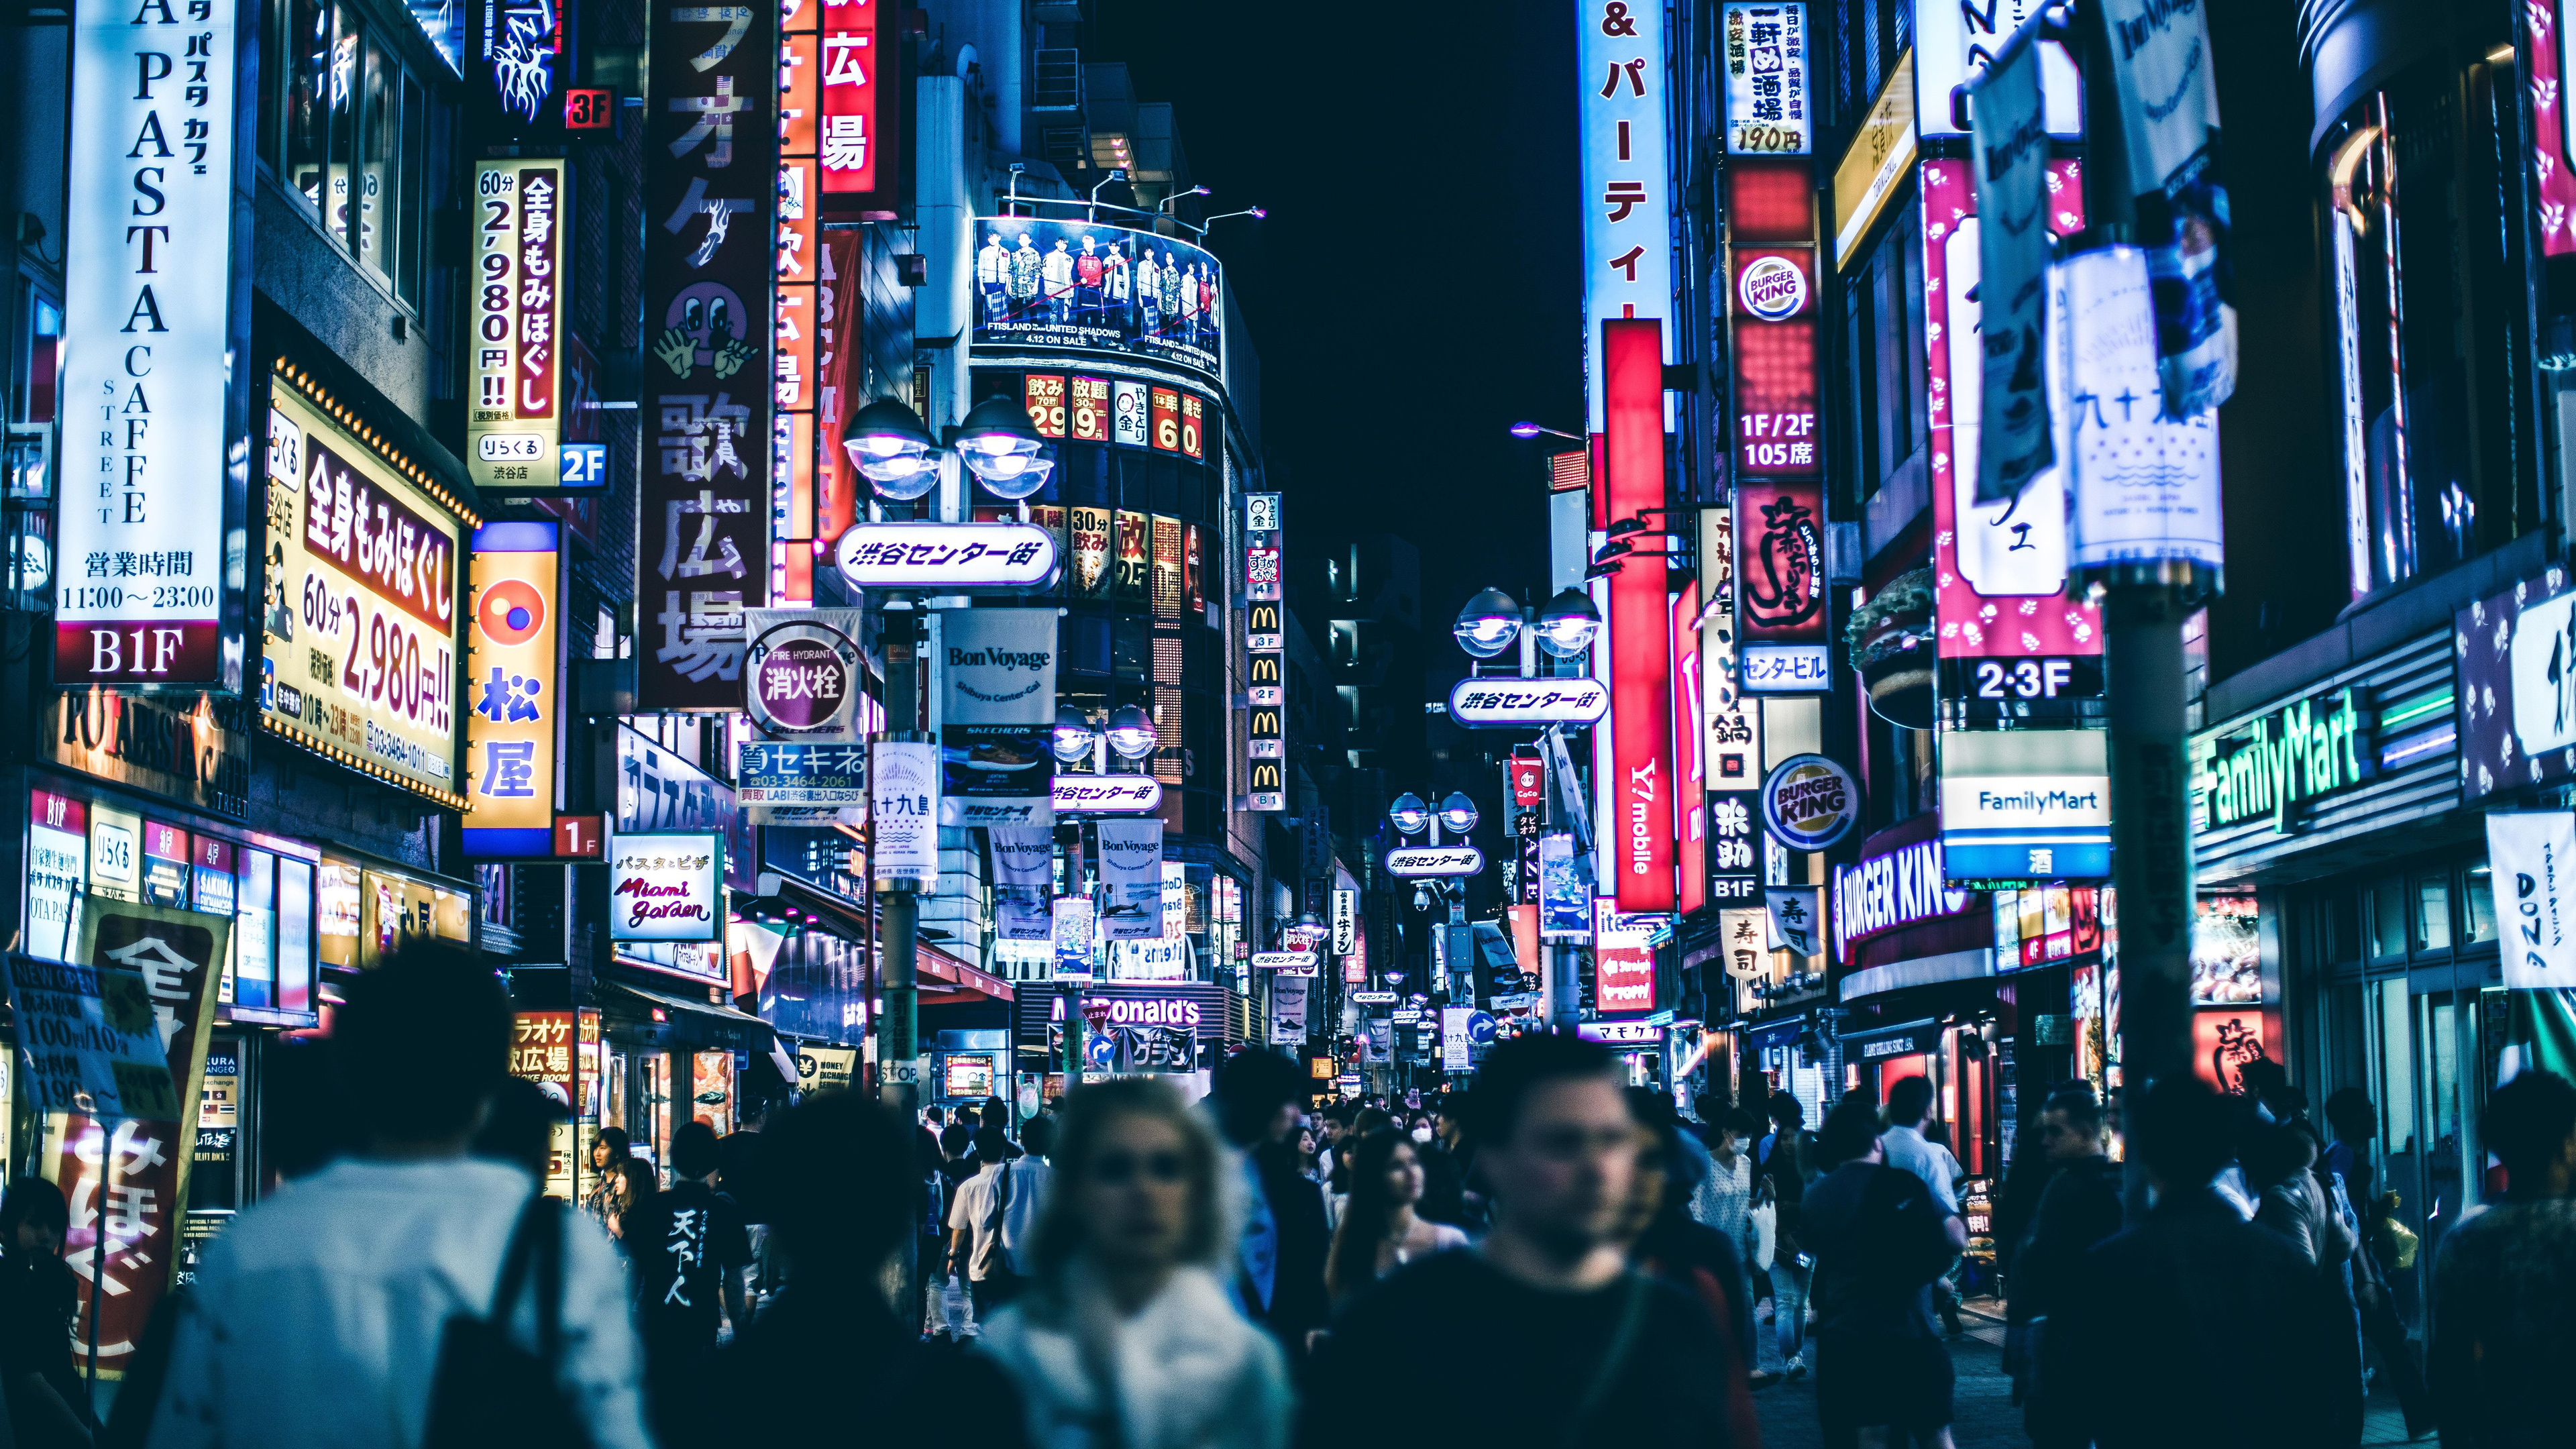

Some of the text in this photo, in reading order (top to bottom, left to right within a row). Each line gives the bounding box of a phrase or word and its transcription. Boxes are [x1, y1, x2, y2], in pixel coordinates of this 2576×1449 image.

[1749, 9, 1784, 121] 一軒め酒場
[822, 0, 870, 171] 広場
[183, 32, 213, 174] パスタ カフェ
[572, 94, 606, 124] 3F
[1738, 127, 1802, 152] 190円
[120, 51, 174, 333] PASTA
[480, 172, 514, 195] 60分
[1750, 270, 1794, 292] BURGER
[1753, 280, 1796, 307] KING
[522, 177, 553, 411] 全身もみほぐし
[987, 323, 1121, 338] FTISLAND UNITED SHADOWS
[1026, 335, 1087, 347] 4.12 ON SALE
[1144, 335, 1175, 348] FTISLAND
[1183, 343, 1201, 356] UNITED
[1171, 352, 1205, 369] 4.12 ON SALE
[1076, 398, 1094, 407] 30分
[1135, 387, 1146, 443] やきとり
[475, 410, 513, 421] (税別価格)
[121, 345, 152, 524] CAFFE
[97, 380, 116, 524] STREET
[485, 440, 537, 455] りらくる
[1745, 441, 1813, 466] 105席
[494, 466, 528, 480] 渋谷店
[562, 451, 603, 482] 2F
[1073, 510, 1108, 532] 30分
[1267, 496, 1276, 529] やきとり
[308, 453, 451, 621] 全身もみほぐし
[1073, 532, 1108, 552] 飲み
[85, 551, 193, 578] 営業時間
[849, 541, 1044, 566] 渋谷センター街
[303, 574, 341, 635] 60分
[89, 628, 183, 673] B1F
[1258, 637, 1274, 647] 3F
[772, 649, 831, 661] FIRE HYDRANT
[948, 647, 1051, 672] Bon Voyage
[1744, 657, 1827, 680] センタービル
[766, 664, 840, 701] 消火栓
[955, 680, 991, 702] Shibuya
[1258, 690, 1274, 699] 2F
[1461, 692, 1601, 709] 渋谷センター街
[478, 667, 541, 797] 松屋
[375, 727, 426, 775] 03-3464-1011
[1259, 742, 1275, 752] 1F
[2199, 686, 2361, 835] FamilyMart
[760, 775, 853, 788] 03-3464-2061
[1052, 786, 1155, 800] 渋谷センター街
[1777, 775, 1843, 806] BURGER
[741, 789, 765, 802] 買取
[1979, 790, 2098, 815] FamilyMart
[46, 798, 66, 828] B1F
[1631, 757, 1656, 875] Y!mobile
[1780, 792, 1846, 827] KING
[565, 821, 596, 853] 1F
[994, 841, 1051, 856] Bon Voyage
[1102, 840, 1160, 853] Bon Voyage
[98, 835, 130, 870] りらくる
[615, 855, 710, 871] パスタとピザ
[1391, 854, 1477, 869] 渋谷センター街
[2029, 848, 2053, 875] 酒
[200, 874, 233, 900] SAKURA
[614, 877, 690, 898] Miami
[1715, 881, 1755, 898] B1F
[1898, 841, 1944, 921] KIN
[1843, 856, 1896, 940] BURGER
[1337, 918, 1351, 953] 牛タン
[1780, 897, 1808, 952] 寿司
[1733, 919, 1758, 973] 寿司
[1255, 955, 1311, 964] 渋谷センター街
[1051, 996, 1201, 1025] Monald's
[1087, 1012, 1108, 1020] 止まれ
[514, 1018, 571, 1044] ラオケ
[820, 1061, 844, 1071] MONEY
[211, 1152, 225, 1162] ROCK
[664, 1209, 697, 1308] 天下人
